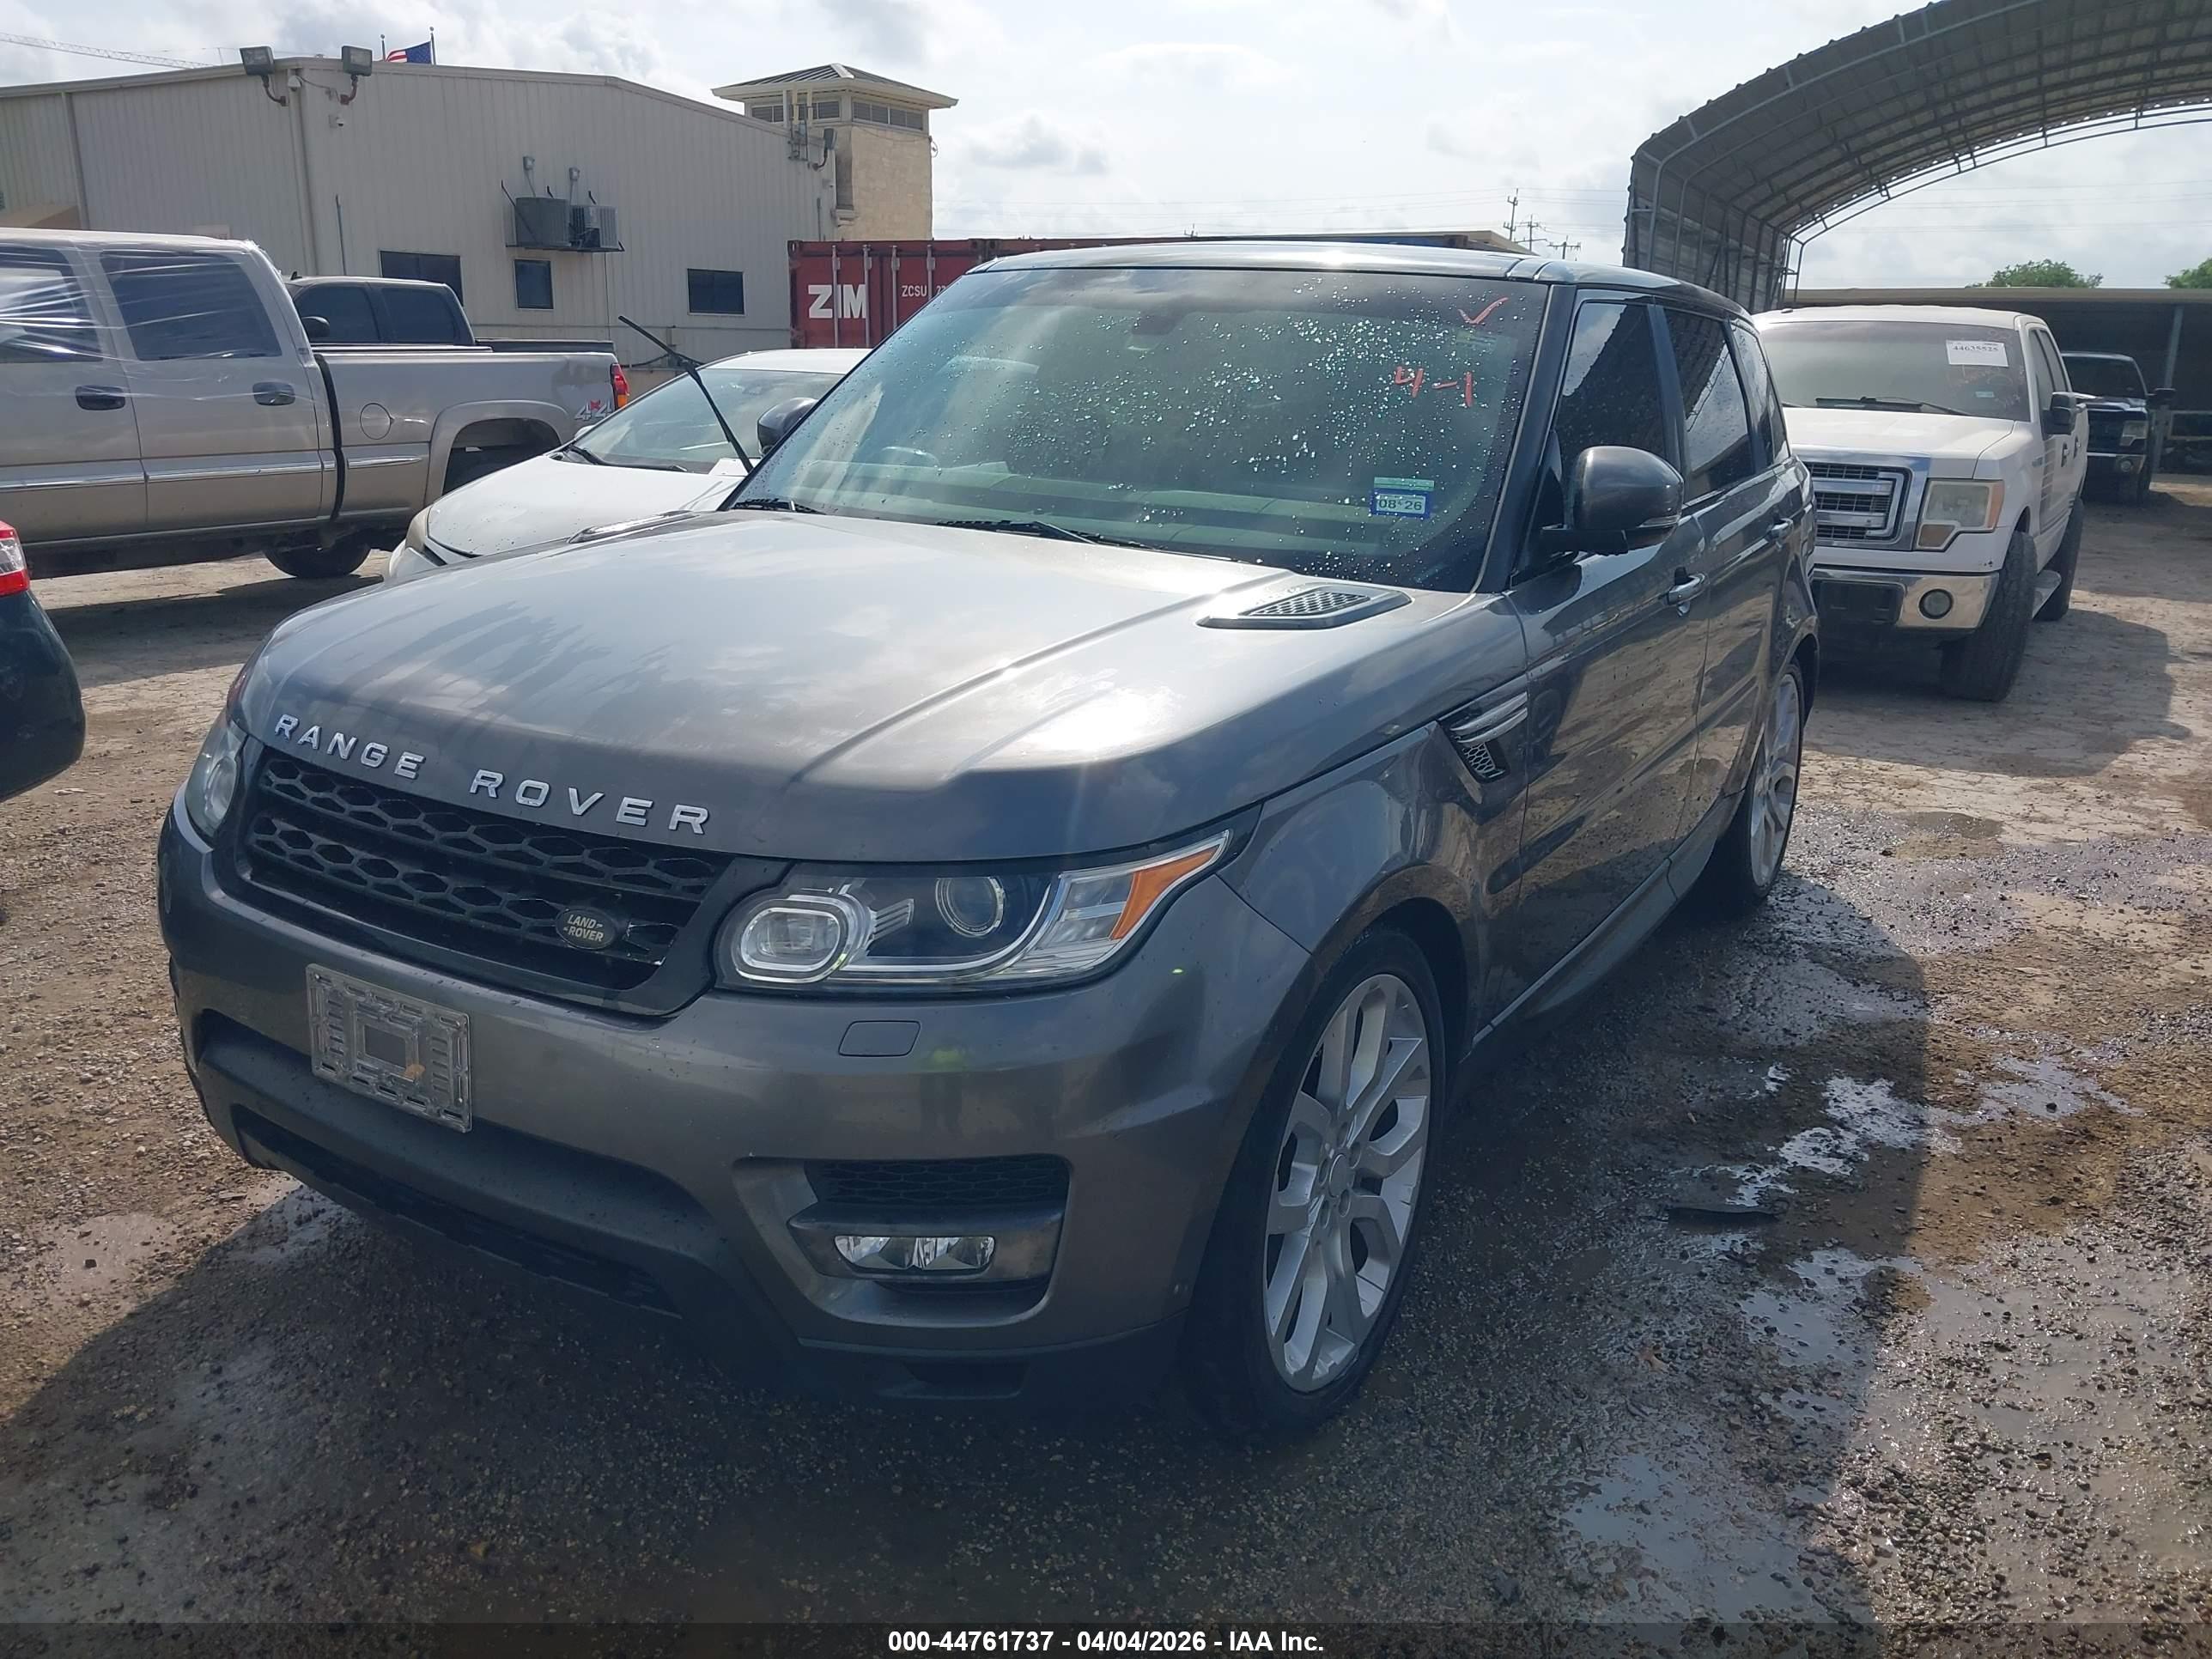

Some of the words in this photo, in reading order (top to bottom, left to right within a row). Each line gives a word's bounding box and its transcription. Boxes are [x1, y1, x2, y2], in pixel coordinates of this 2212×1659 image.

[808, 284, 866, 319] ZIM
[902, 285, 927, 297] ZCSU
[1395, 366, 1473, 407] 4-1
[274, 714, 426, 780] RANGE
[469, 769, 710, 835] ROVER
